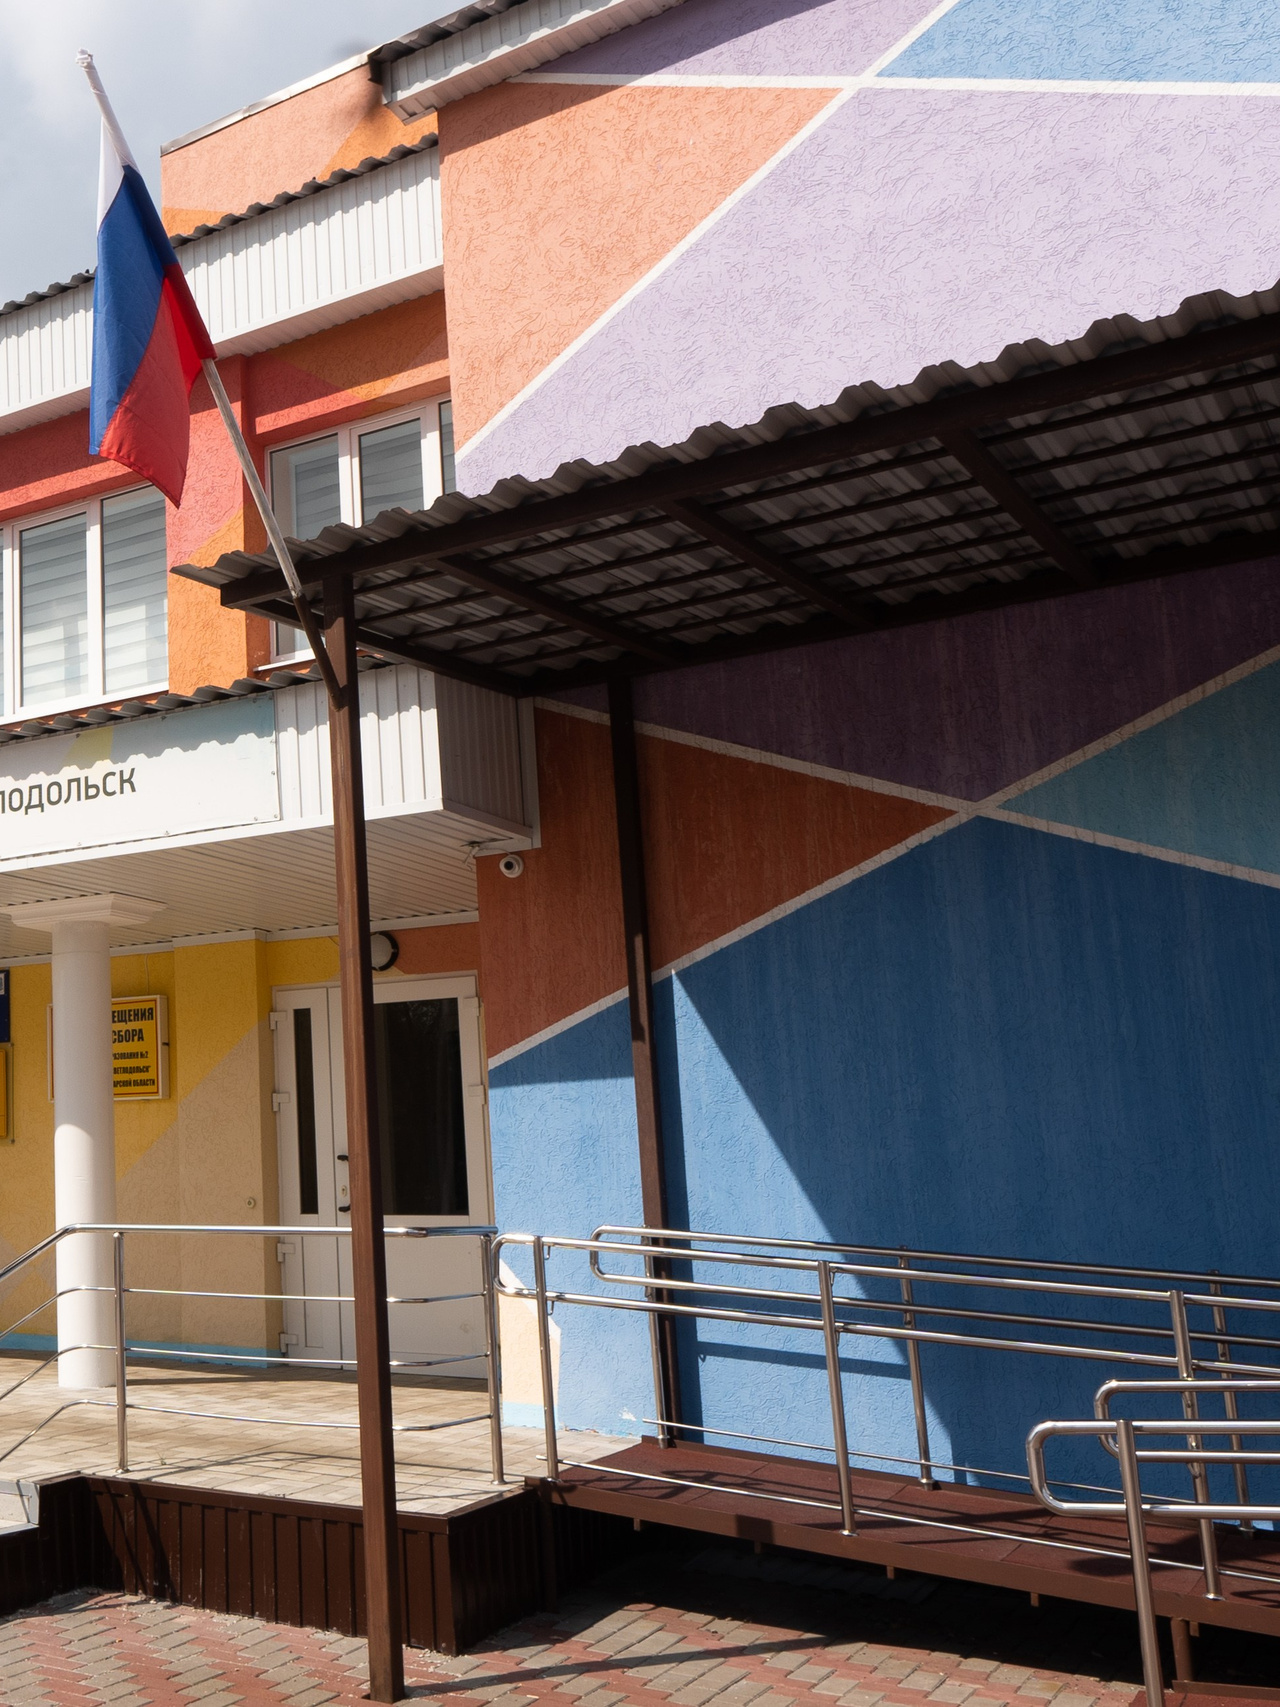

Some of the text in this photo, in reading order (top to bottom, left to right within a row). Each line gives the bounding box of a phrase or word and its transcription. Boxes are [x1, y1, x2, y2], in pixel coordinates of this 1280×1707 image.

[112, 1007, 154, 1024] ЕЩЕНИЯ
[112, 1028, 144, 1044] СБОРА
[112, 1052, 139, 1060] АЗОВАНИЯ
[113, 1065, 151, 1075] ВЕТЛОДОЛЬСК"
[113, 1078, 155, 1088] АРСКОЙ ОБЛАСТИ
